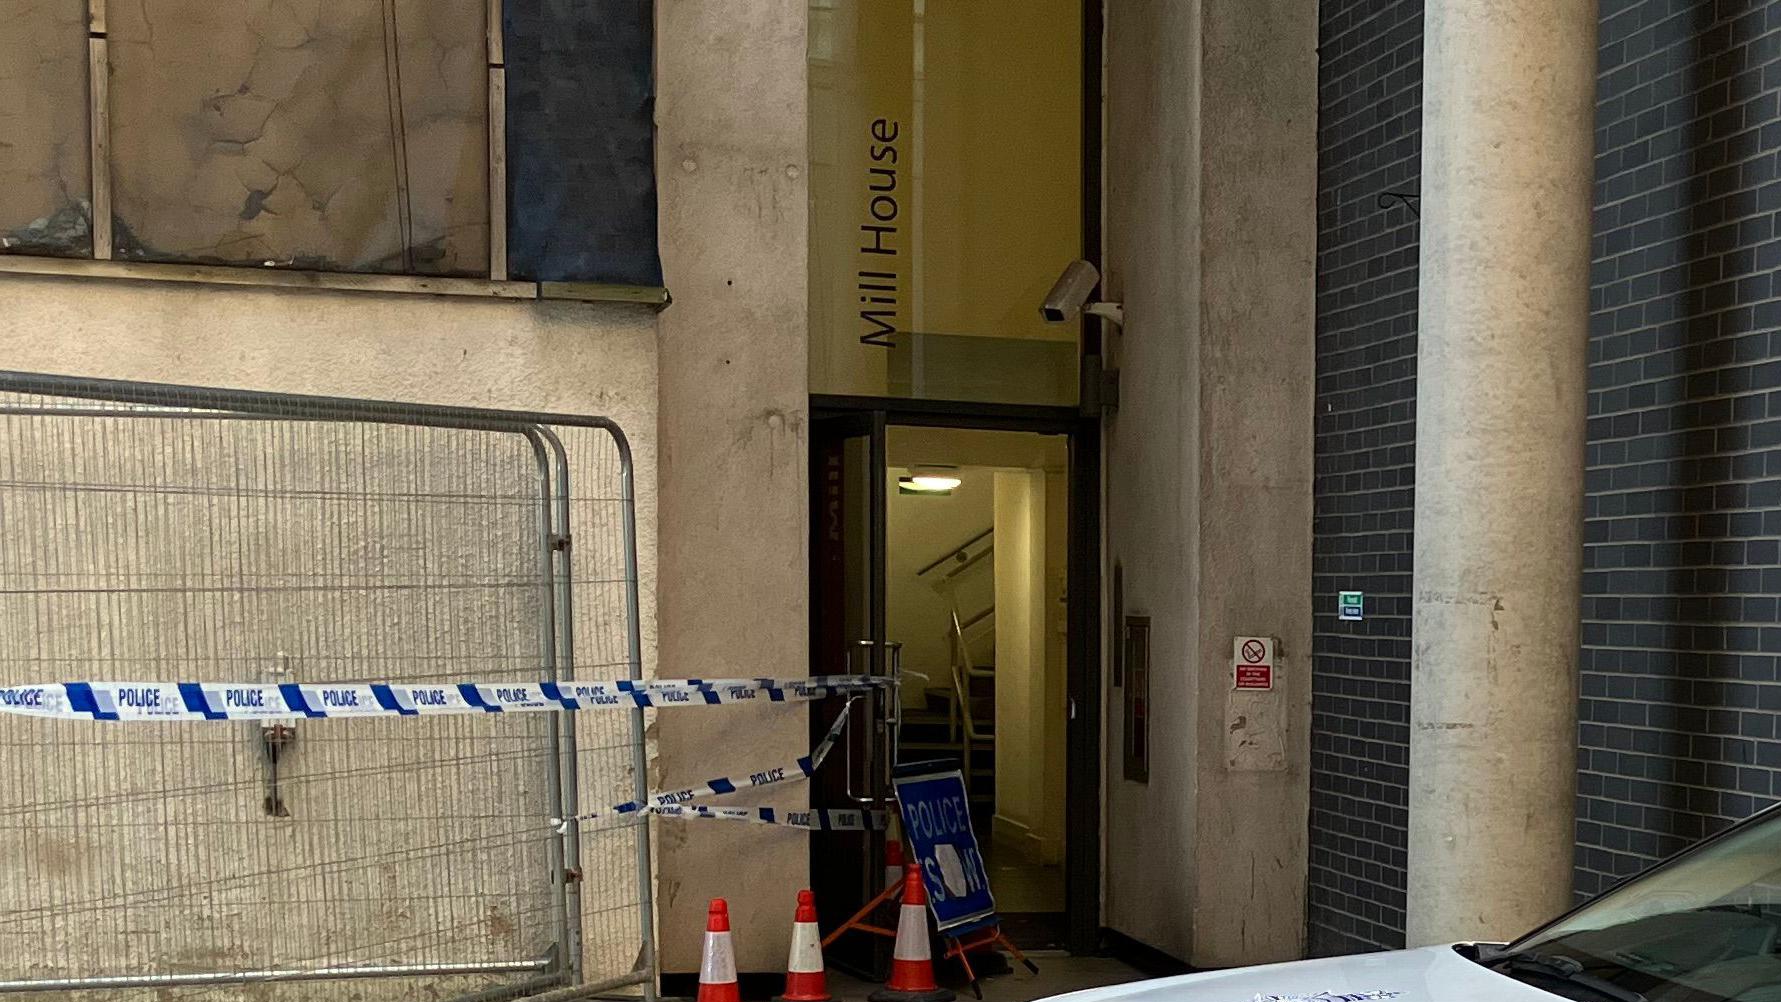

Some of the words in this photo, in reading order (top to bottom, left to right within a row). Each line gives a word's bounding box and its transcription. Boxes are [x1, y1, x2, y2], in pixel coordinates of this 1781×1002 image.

[860, 117, 899, 255] House
[858, 271, 897, 349] Mill
[118, 688, 161, 707] POLICE
[226, 689, 265, 707] POLICE
[322, 689, 360, 707] POLICE
[411, 689, 447, 706] POLICE
[496, 688, 527, 702] POLICE
[750, 768, 785, 786] POLICE
[657, 789, 695, 805] POLICE
[907, 796, 967, 840] POLICE
